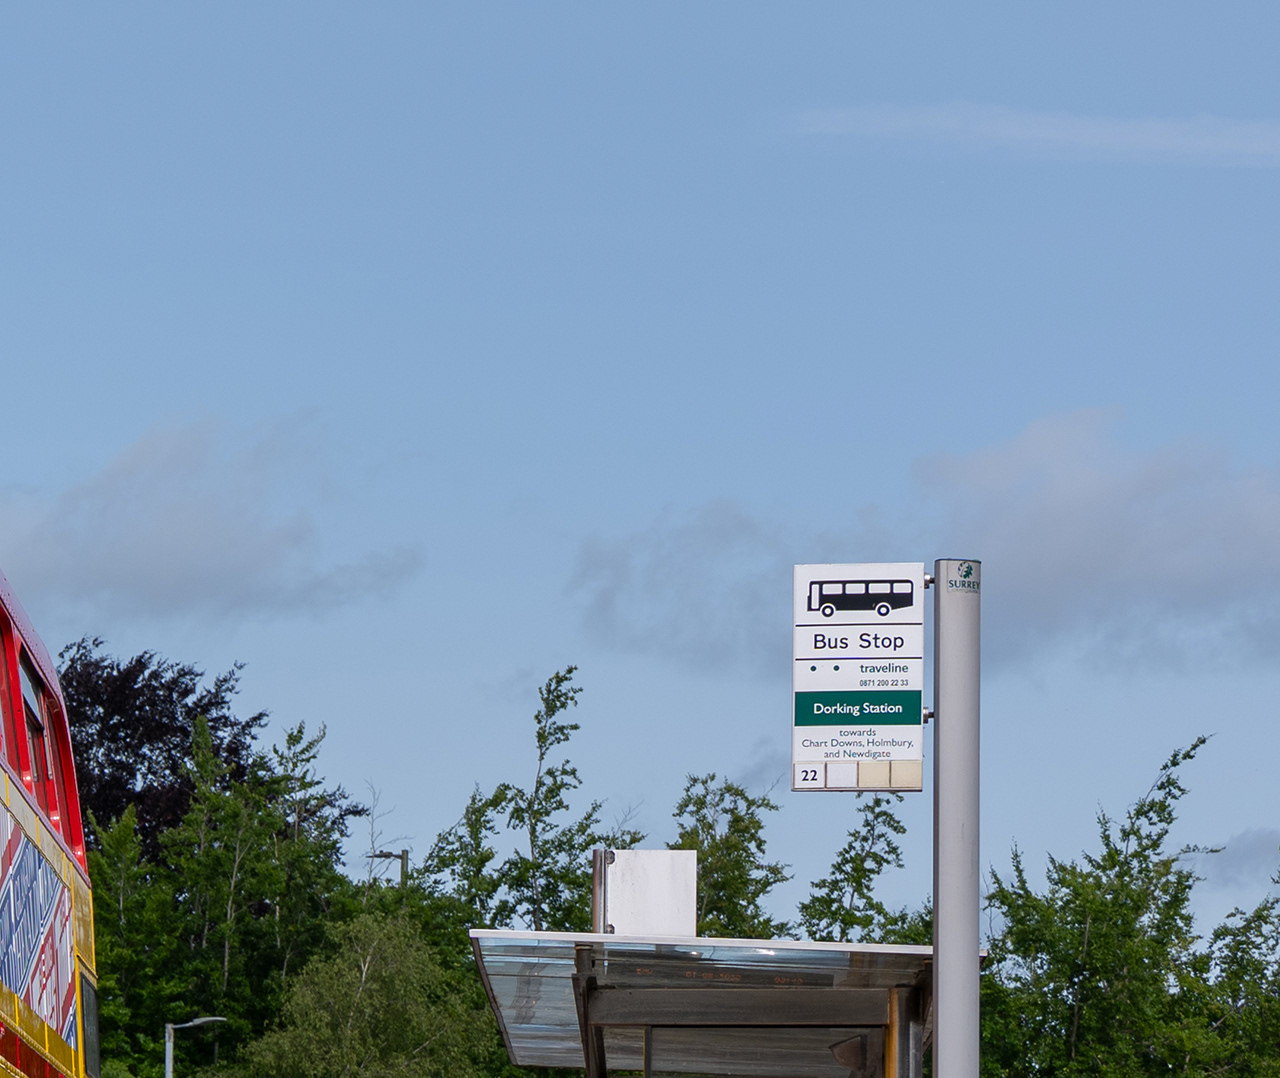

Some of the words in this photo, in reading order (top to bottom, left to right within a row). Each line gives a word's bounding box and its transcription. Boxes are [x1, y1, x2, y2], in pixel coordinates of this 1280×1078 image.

[948, 579, 980, 590] SURREY
[813, 633, 849, 650] Bus
[858, 632, 905, 652] Stop
[859, 663, 909, 674] traveline
[859, 679, 876, 687] 0871
[876, 679, 889, 687] 200
[890, 679, 899, 687] 22
[900, 679, 909, 687] 33
[813, 703, 860, 716] Dorking
[862, 702, 903, 714] Station
[839, 728, 877, 738] towards
[801, 738, 828, 748] Chart
[830, 739, 865, 749] Downs,
[866, 738, 914, 750] Holmbury,
[823, 750, 840, 759] and
[842, 750, 891, 760] Newdigate
[801, 769, 818, 782] 22
